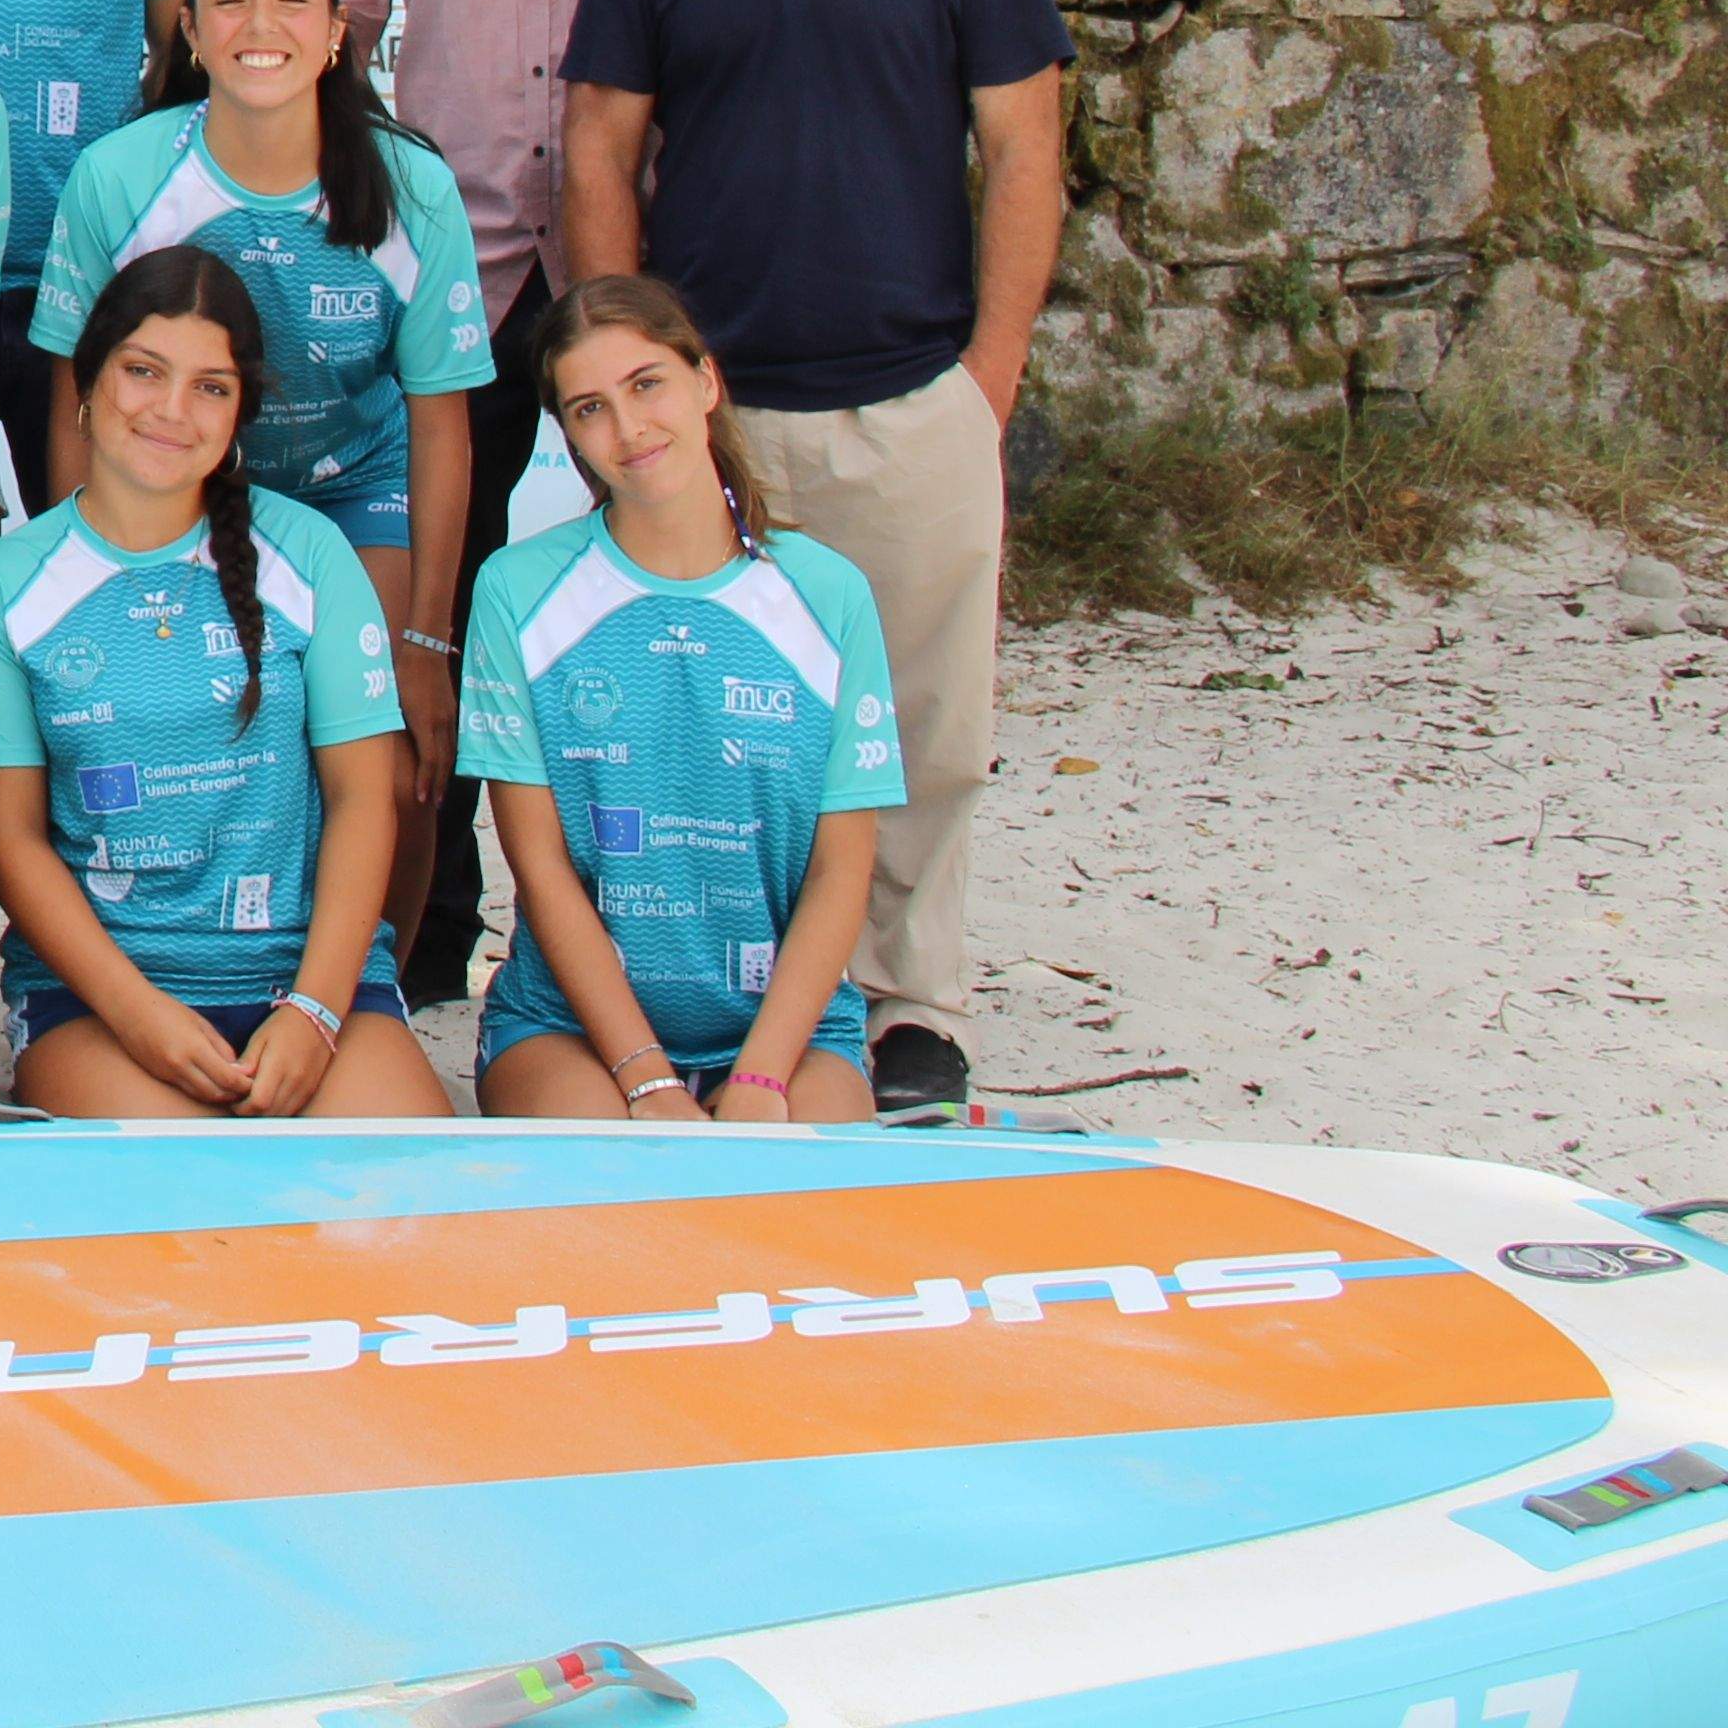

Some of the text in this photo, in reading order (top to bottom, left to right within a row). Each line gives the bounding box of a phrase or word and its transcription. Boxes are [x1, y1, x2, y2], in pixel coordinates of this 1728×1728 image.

[239, 248, 296, 266] amura
[128, 602, 184, 620] amura
[648, 638, 707, 656] amura
[50, 709, 91, 727] WAIRA
[560, 745, 608, 762] WAIRA
[143, 749, 277, 780] Cofinanciado por la
[145, 772, 247, 798] Unión Europea
[649, 815, 736, 834] Cofinanciado
[111, 835, 171, 853] XUNTA
[687, 833, 747, 853] Europea
[112, 847, 206, 870] DE GALICIA
[606, 883, 666, 900] XUNTA
[605, 900, 696, 918] DE GALICIA
